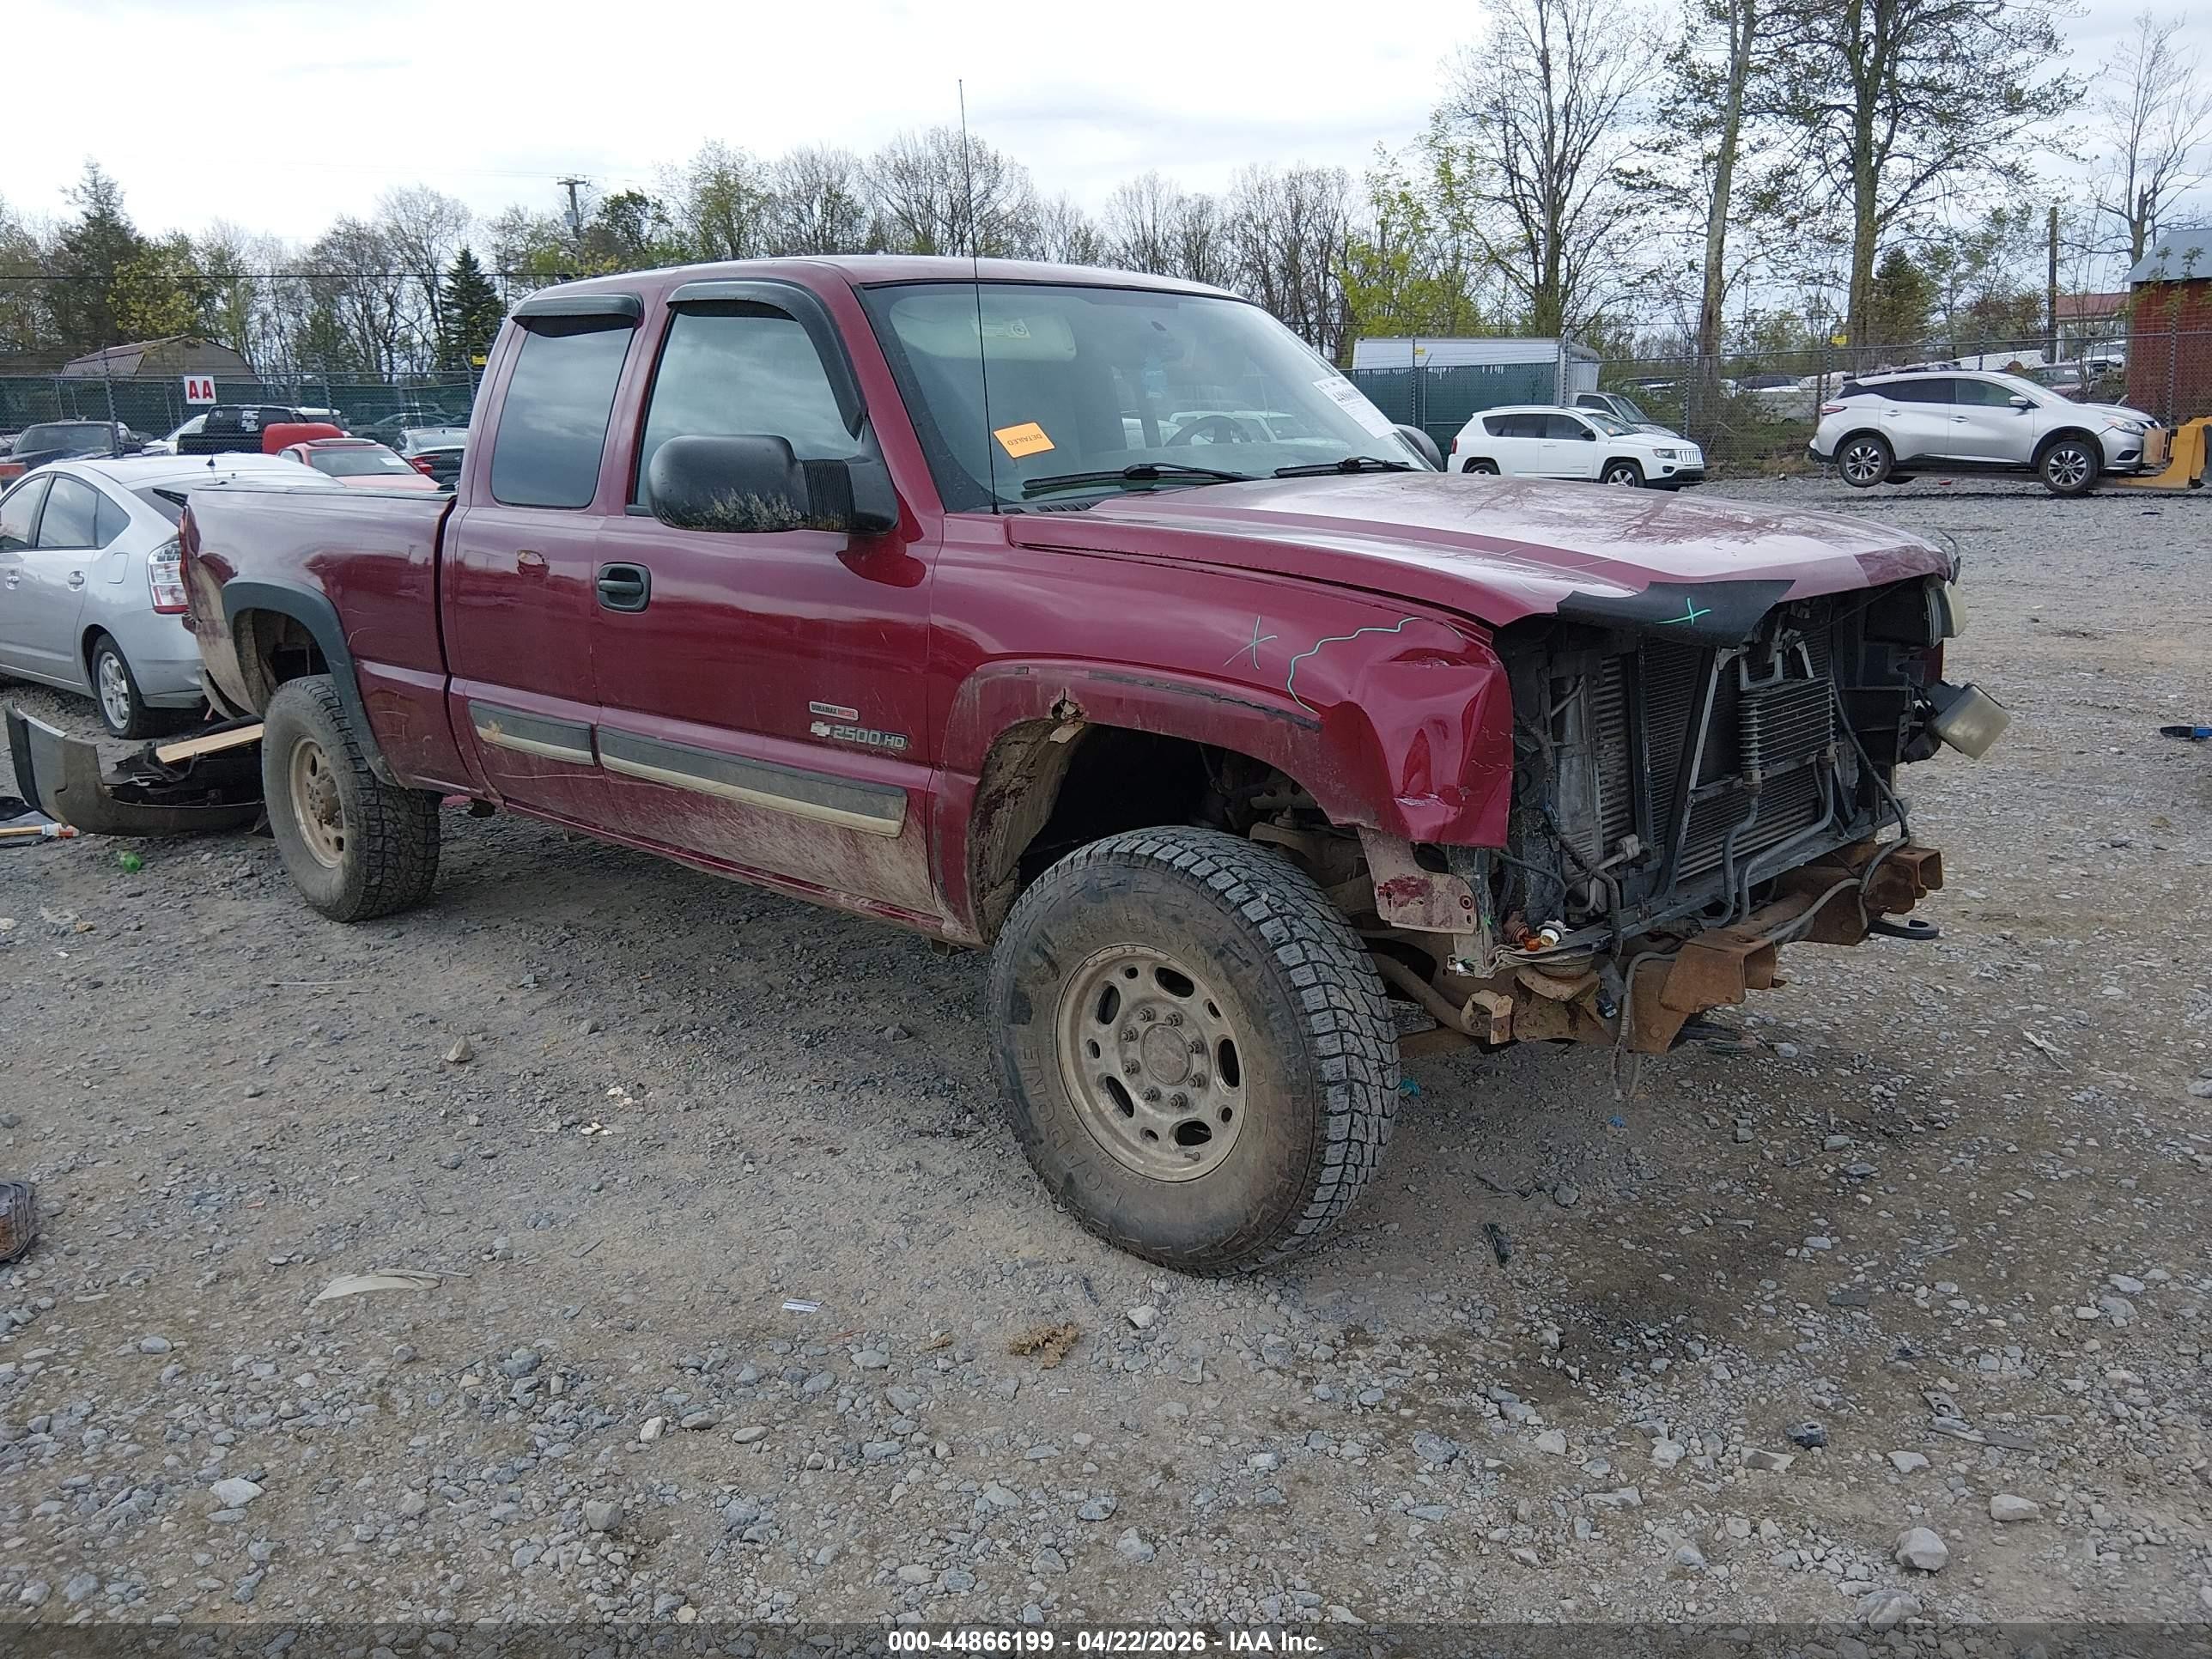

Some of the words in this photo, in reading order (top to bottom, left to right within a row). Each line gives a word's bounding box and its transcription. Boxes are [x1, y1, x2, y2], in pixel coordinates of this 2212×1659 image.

[189, 380, 213, 398] AA
[1006, 433, 1043, 446] DETAILED
[834, 725, 881, 745] 2500
[884, 733, 905, 749] HD
